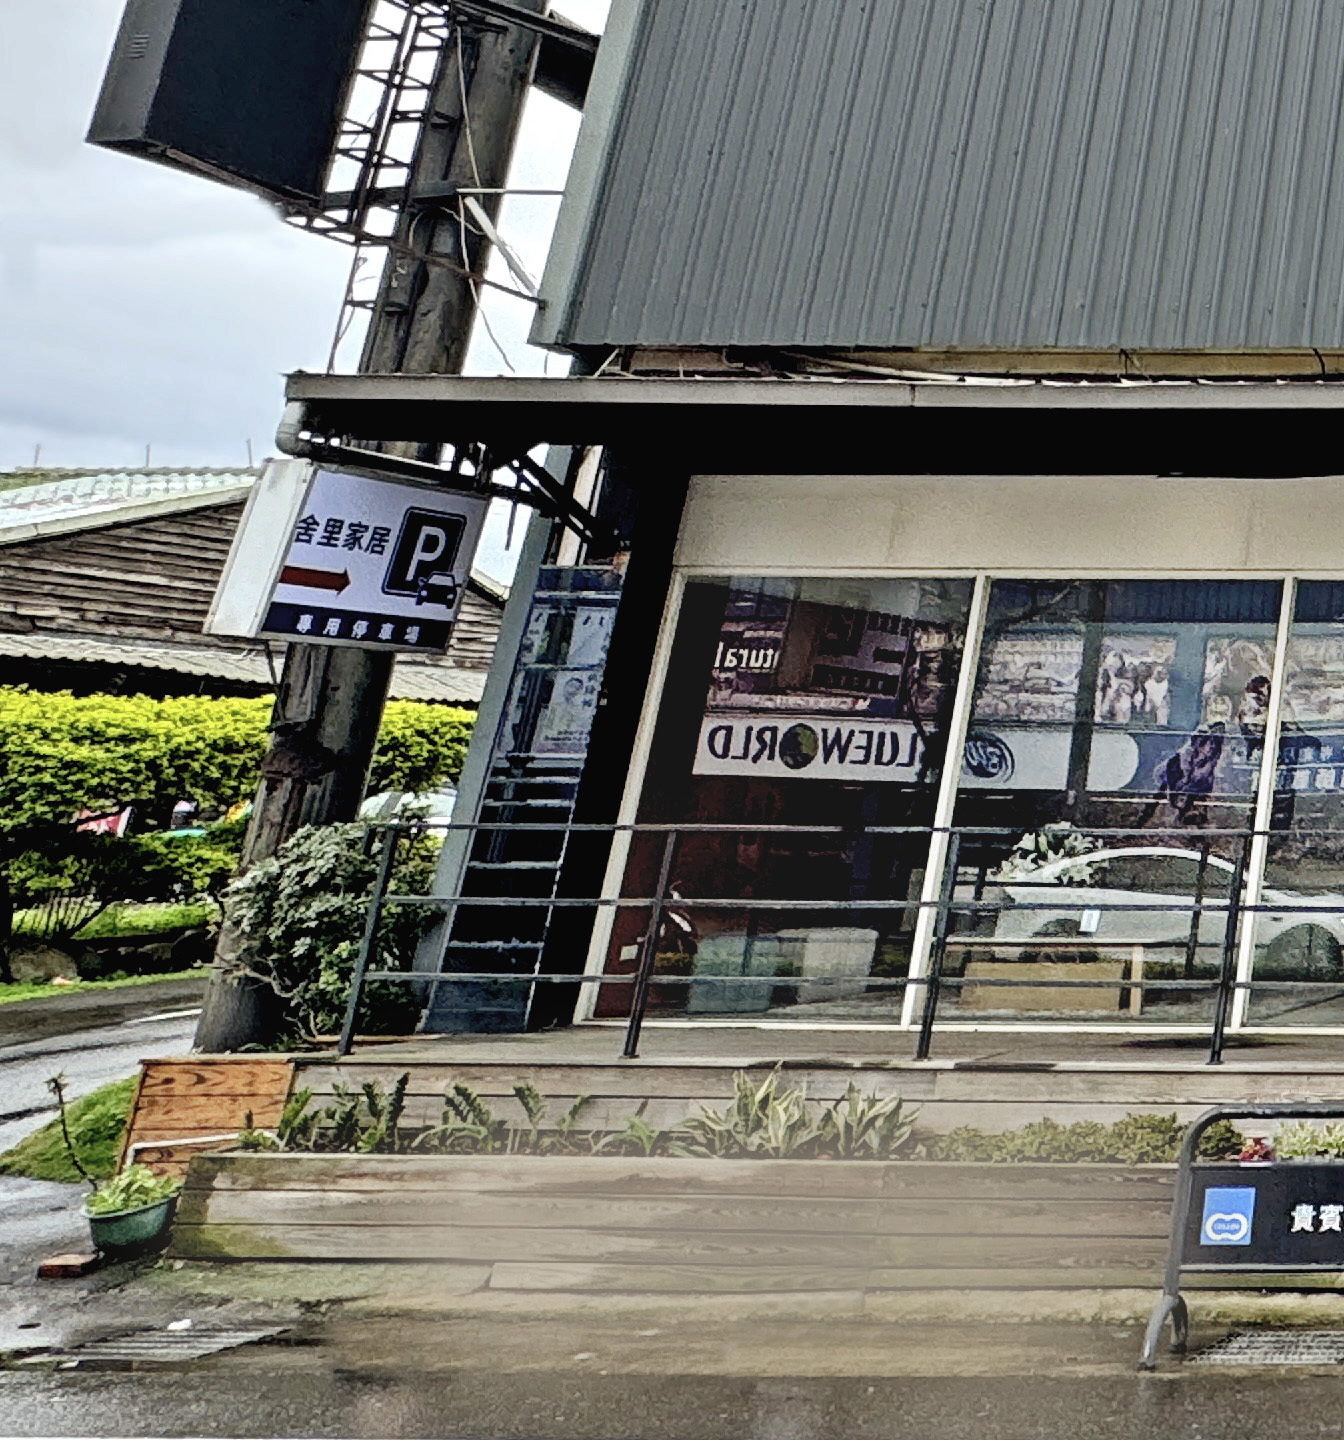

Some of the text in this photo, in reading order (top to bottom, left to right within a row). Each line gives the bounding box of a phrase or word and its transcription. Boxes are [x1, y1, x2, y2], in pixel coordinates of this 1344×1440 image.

[294, 514, 392, 556] 舍里家居
[405, 525, 447, 582] P
